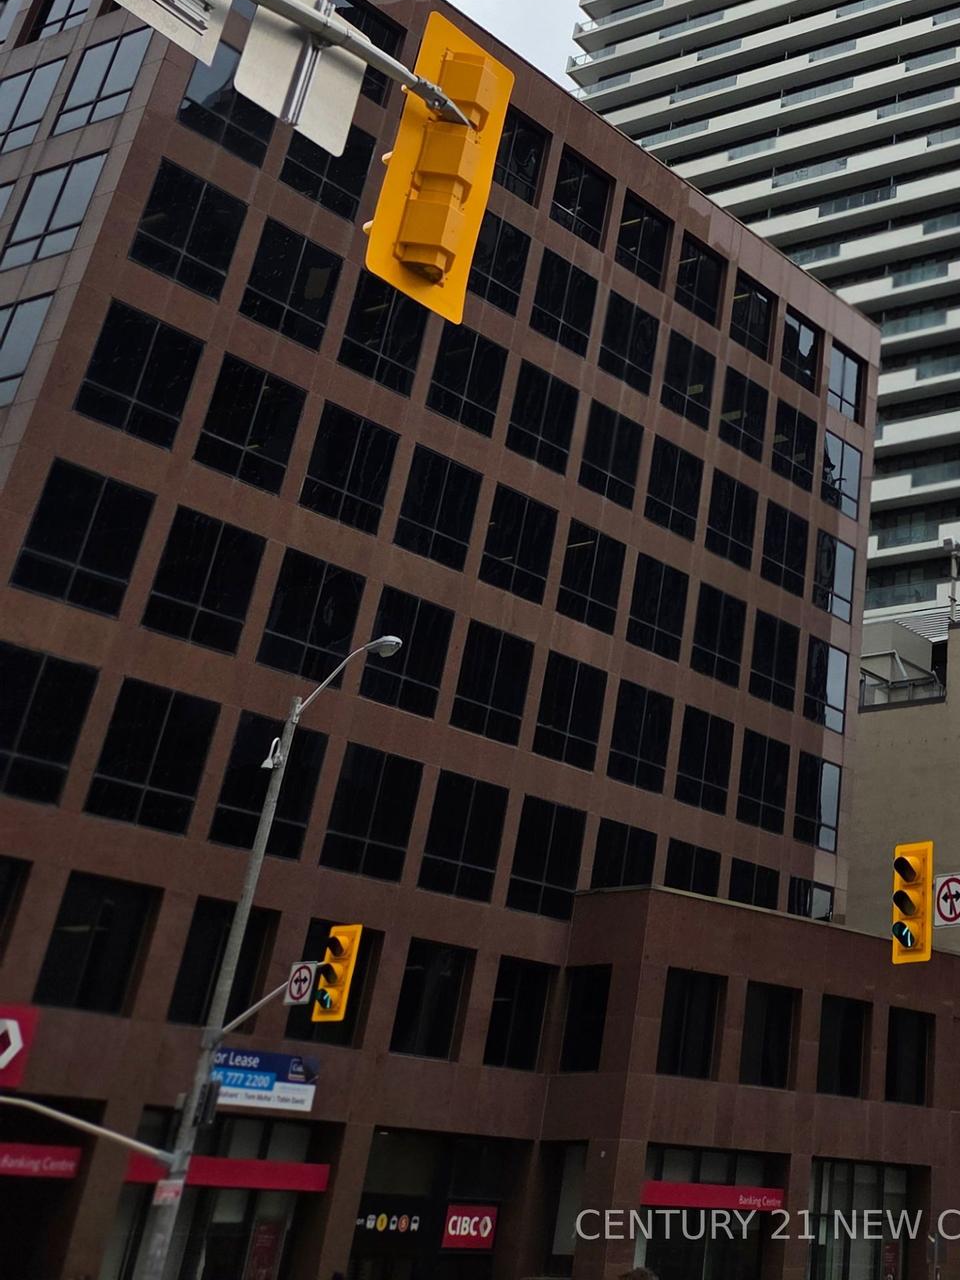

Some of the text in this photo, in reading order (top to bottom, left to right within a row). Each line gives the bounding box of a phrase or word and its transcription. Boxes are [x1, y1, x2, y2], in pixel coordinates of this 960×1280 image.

[213, 1051, 260, 1069] or Lease
[739, 1194, 782, 1207] Banking Centre
[448, 1215, 479, 1237] CIBC
